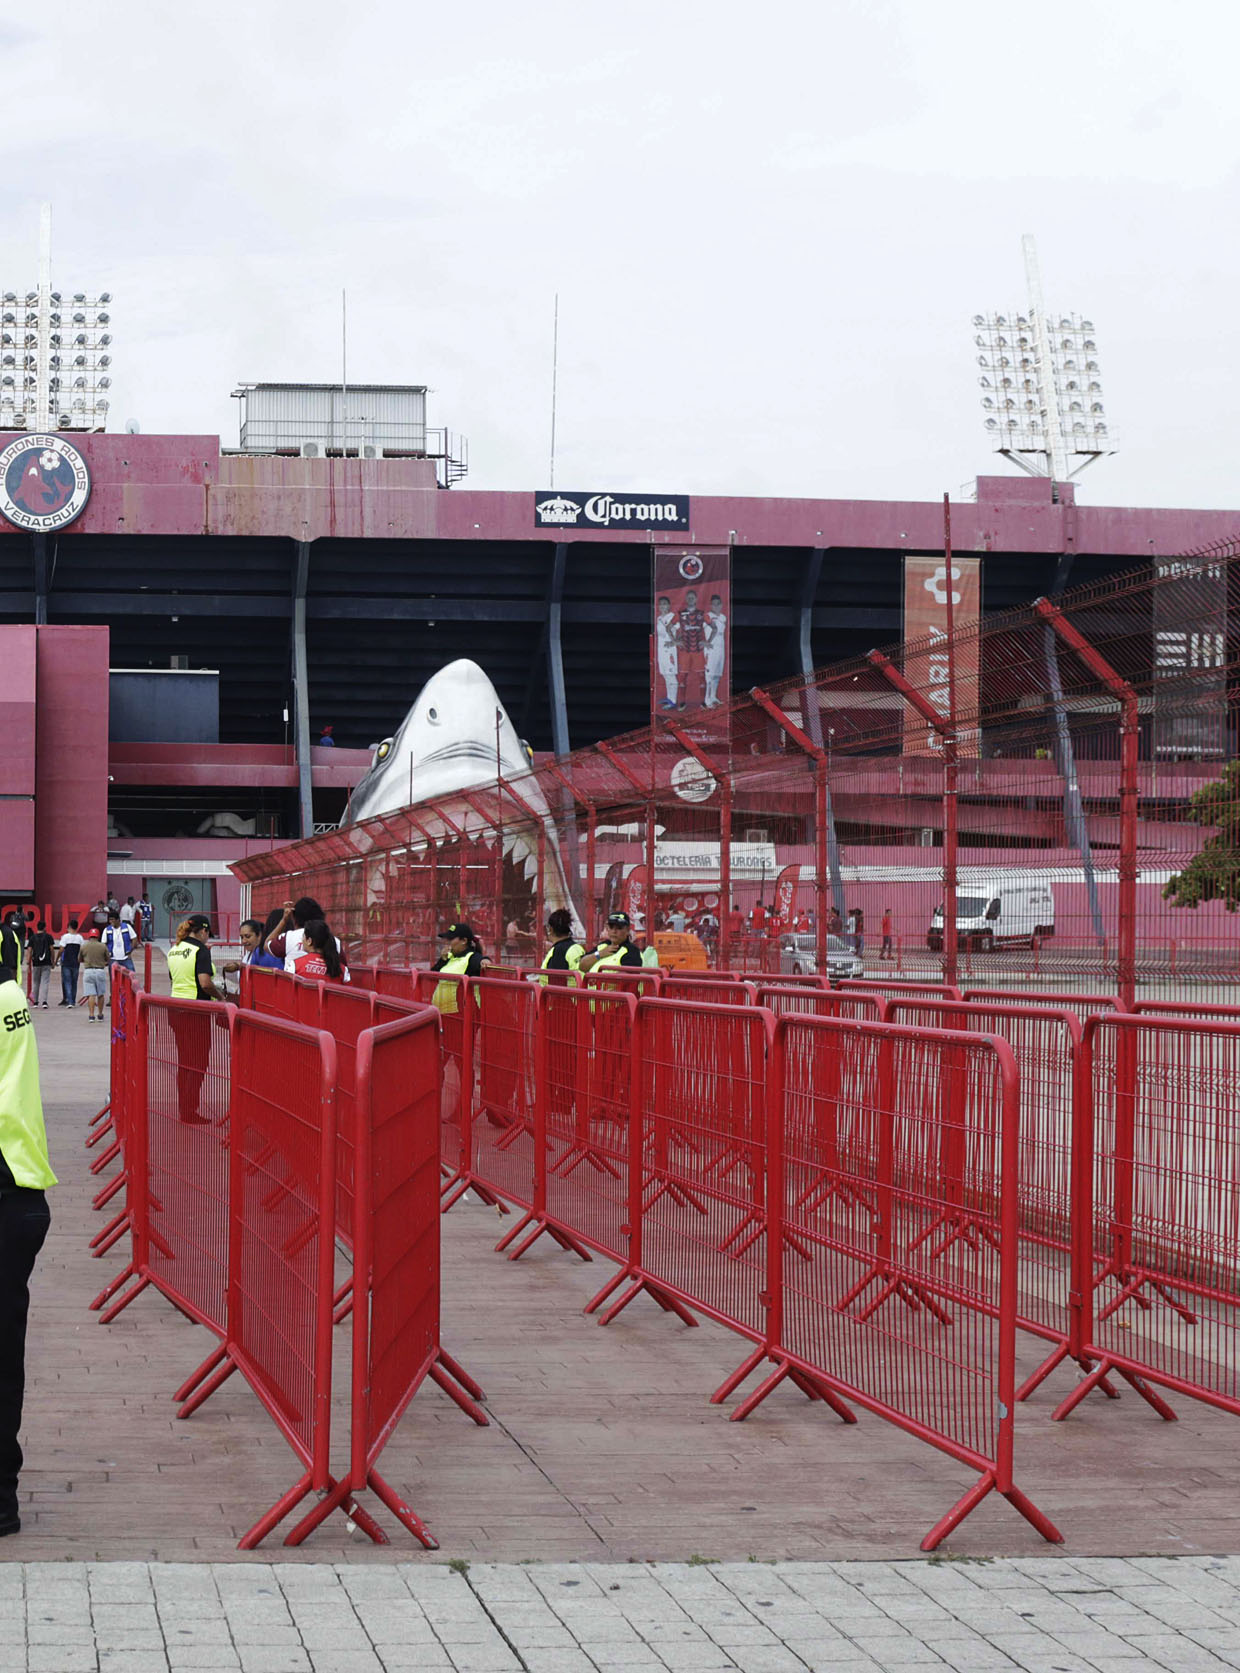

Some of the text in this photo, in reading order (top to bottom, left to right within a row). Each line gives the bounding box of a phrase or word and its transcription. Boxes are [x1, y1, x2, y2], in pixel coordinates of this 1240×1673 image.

[60, 444, 87, 491] ROJOS
[3, 501, 80, 527] VERACRUZ
[584, 495, 679, 525] Corona
[305, 963, 328, 975] TECA
